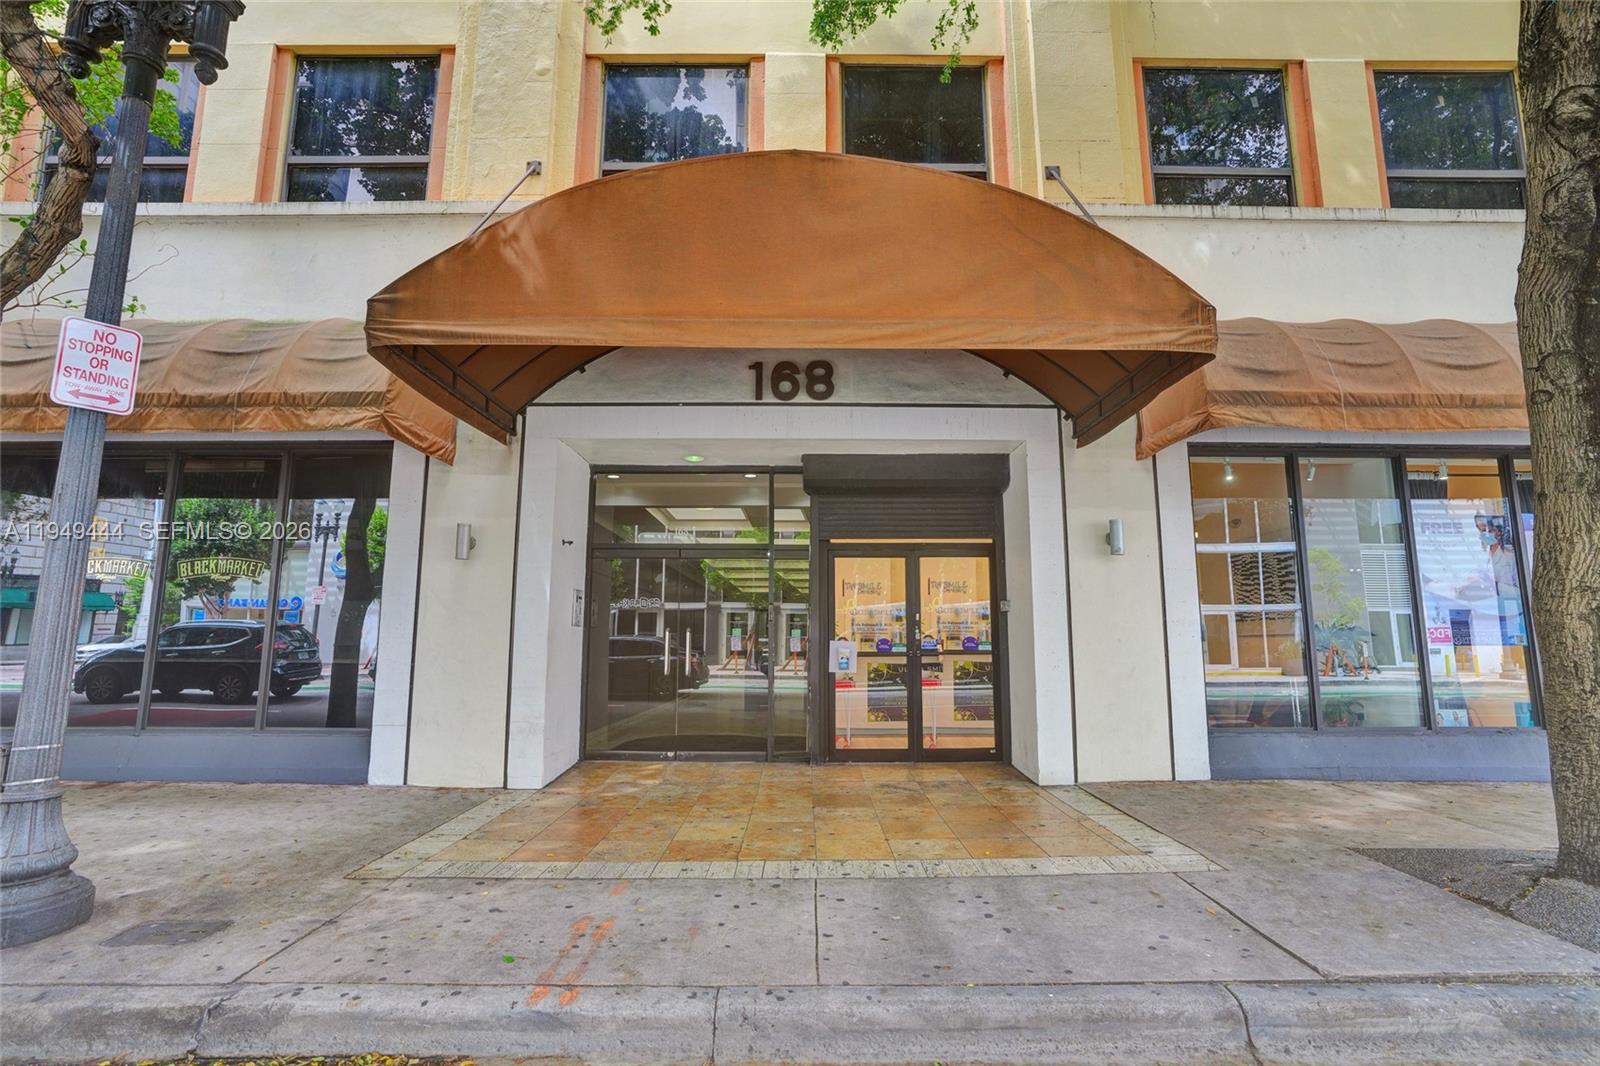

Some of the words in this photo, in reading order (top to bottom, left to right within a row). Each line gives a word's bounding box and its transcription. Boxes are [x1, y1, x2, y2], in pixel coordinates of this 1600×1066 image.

[93, 329, 117, 345] NO
[68, 338, 133, 362] STOPPING
[89, 357, 109, 371] OR
[63, 366, 129, 389] STANDING
[748, 360, 834, 401] 168
